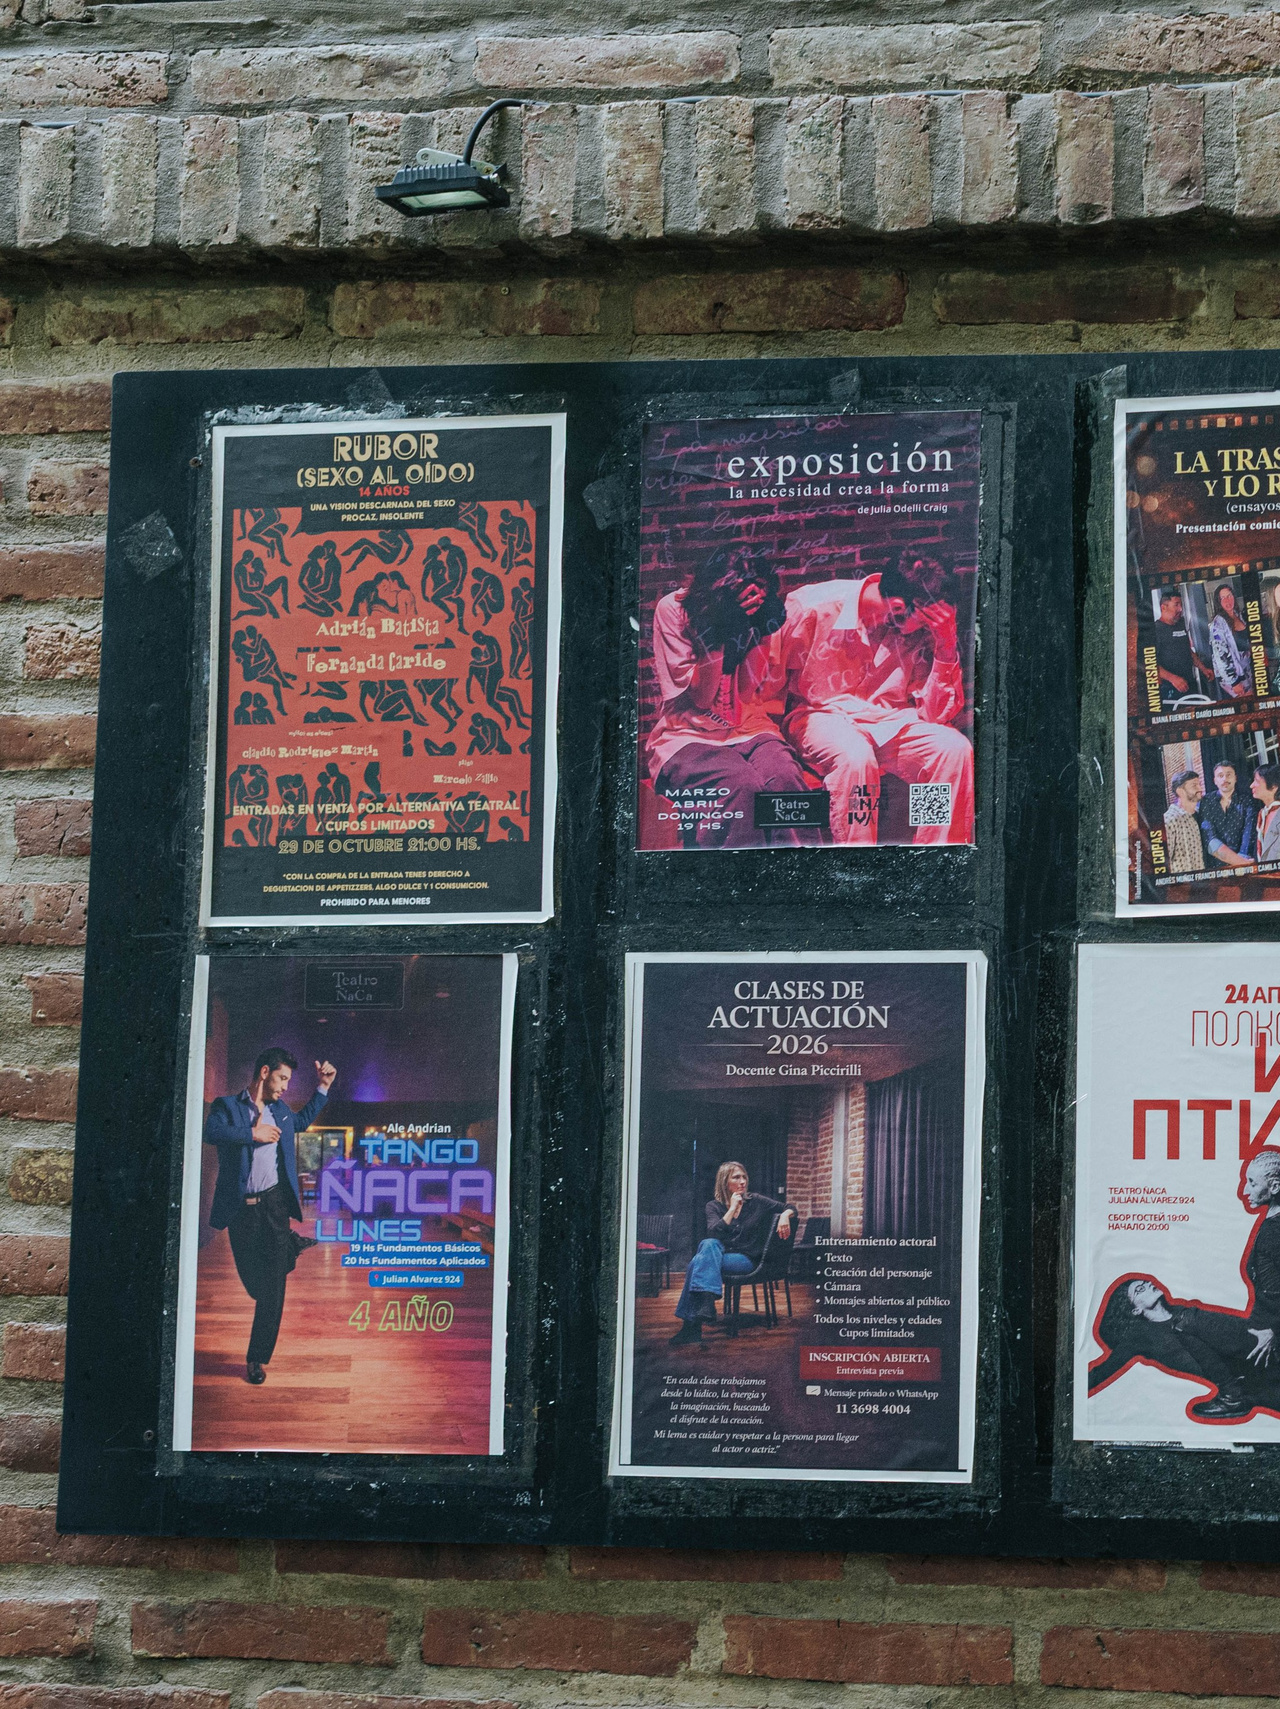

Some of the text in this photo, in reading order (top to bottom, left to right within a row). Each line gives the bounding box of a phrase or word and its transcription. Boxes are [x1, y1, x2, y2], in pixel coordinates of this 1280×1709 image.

[334, 433, 439, 462] RUBOR
[727, 442, 953, 485] exposición
[1174, 451, 1210, 475] LA
[297, 462, 475, 488] (SEXO AL OÍDO)
[359, 485, 410, 497] 14 AÑOS
[730, 481, 950, 499] la necesidad crea la forma
[1204, 481, 1217, 497] Y
[1223, 476, 1259, 498] LO
[329, 503, 357, 511] VISION
[359, 501, 413, 510] DESCARNADA
[433, 500, 455, 508] SEXO
[858, 503, 948, 515] de Julia Odelli Craig
[341, 512, 424, 522] PROCAZ, INSOLENTE
[1176, 522, 1246, 534] Presentación
[665, 788, 730, 796] MARZO
[233, 800, 519, 816] ENTRADAS EN VENTA POR ALTERNATIVA TEATRAL
[672, 800, 724, 808] ABRIL
[658, 811, 744, 820] DOMINGOS
[303, 840, 323, 853] DE
[329, 838, 403, 853] OCTUBRE
[408, 837, 451, 852] 21:00
[456, 837, 481, 851] HS.
[321, 897, 430, 906] PROHIBIDO PARA MENORES
[734, 981, 864, 1000] CLASES DE
[1225, 984, 1248, 1004] 24
[708, 1002, 890, 1028] ACTUACIÓN
[767, 1035, 828, 1054] 2026
[726, 1064, 861, 1076] Docente Gina Piccirilli
[387, 1123, 451, 1133] Ale Andrian
[360, 1139, 479, 1164] TANGO
[321, 1160, 492, 1213] ÑACA
[316, 1220, 421, 1242] LUNES
[1108, 1223, 1169, 1231] НАЧАЛО 20:00
[815, 1236, 936, 1247] Entrenamiento actoral
[824, 1253, 852, 1263] Texto
[383, 1275, 460, 1284] Julian Alvarez 924
[824, 1282, 861, 1291] Cámara
[349, 1295, 454, 1331] 4 AÑO
[809, 1352, 930, 1363] INSCRIPCIÓN ABIERTA
[836, 1404, 911, 1414] 11 3698 4004
